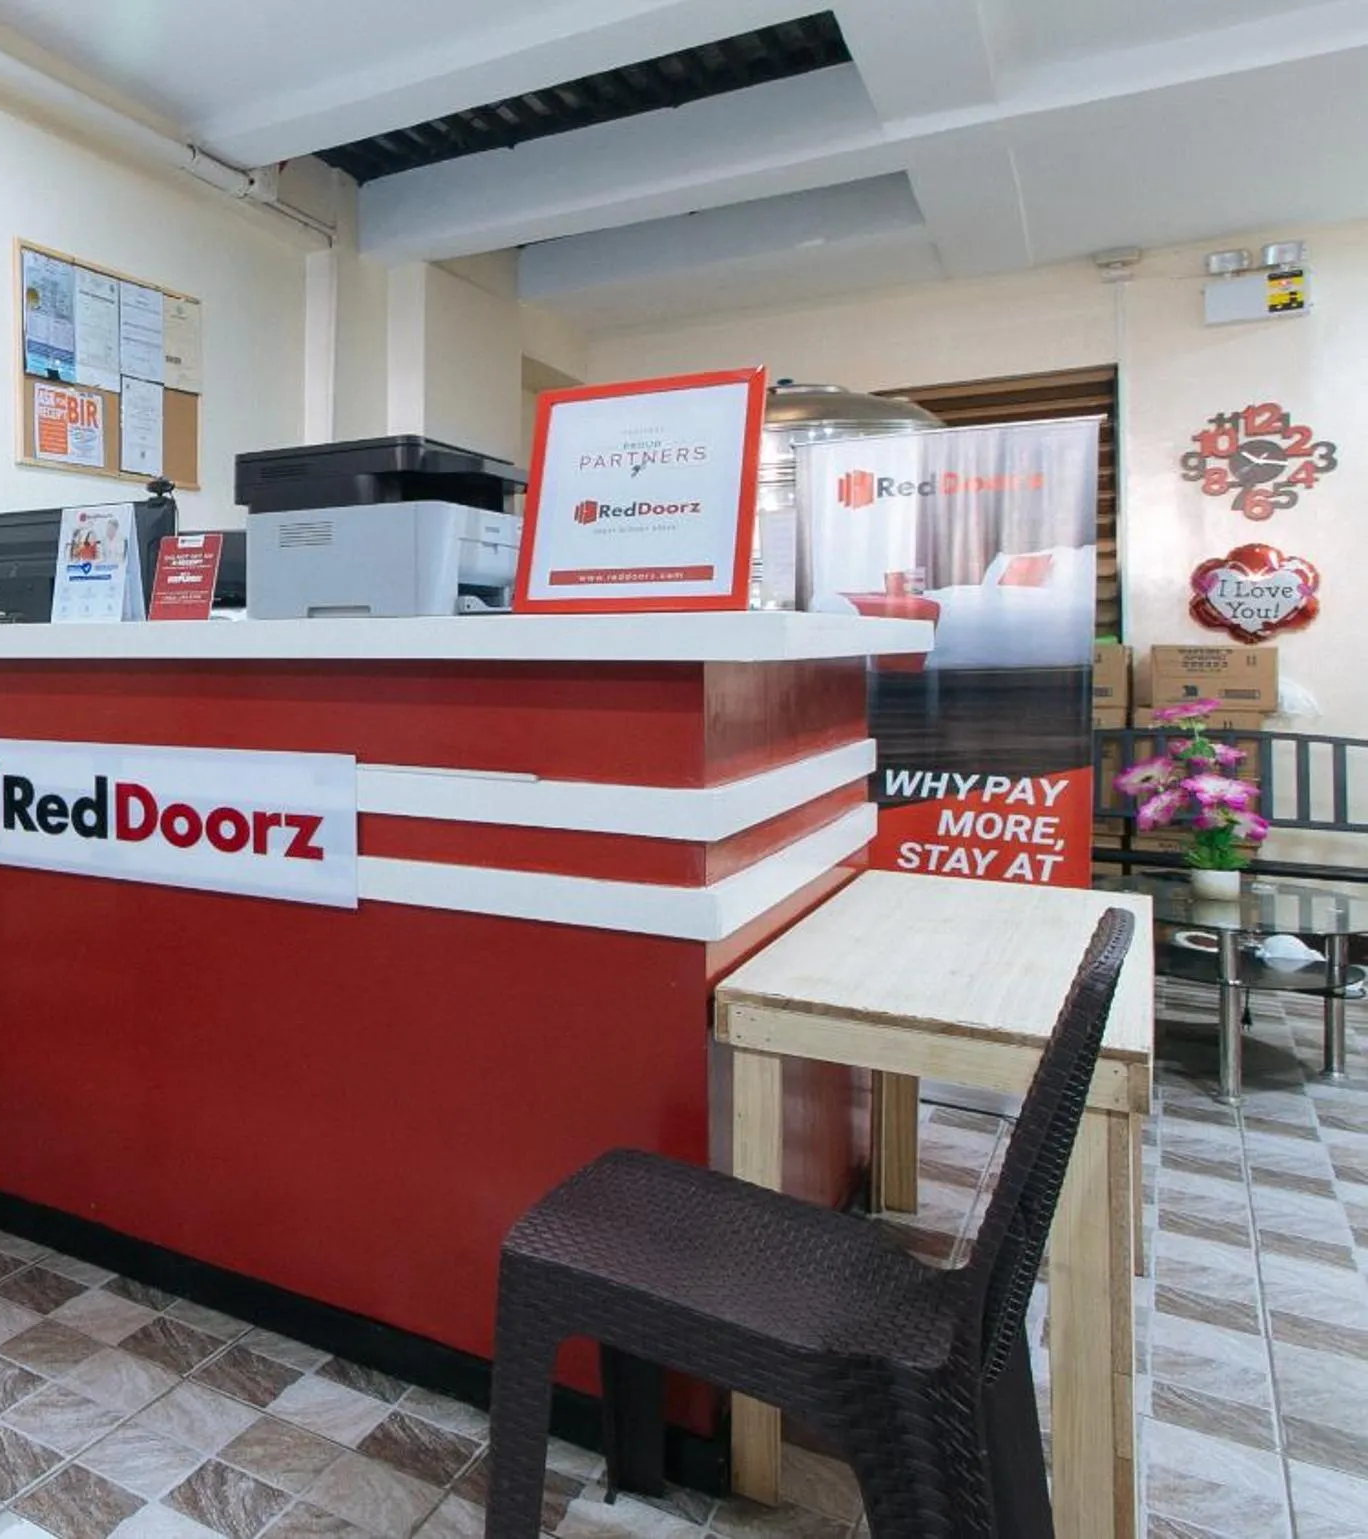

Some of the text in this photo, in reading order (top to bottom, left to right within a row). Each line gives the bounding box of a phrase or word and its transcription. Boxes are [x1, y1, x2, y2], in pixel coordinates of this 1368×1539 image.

[67, 396, 99, 428] BIR
[579, 446, 707, 471] PARTNERS
[599, 501, 701, 519] RedDoorz
[1218, 579, 1293, 599] I Love
[1227, 601, 1280, 619] You!
[885, 769, 1070, 807] WHY PAY
[3, 774, 325, 861] RedDoorz
[937, 809, 1065, 852] MORE,
[897, 841, 1064, 882] STAY AT
